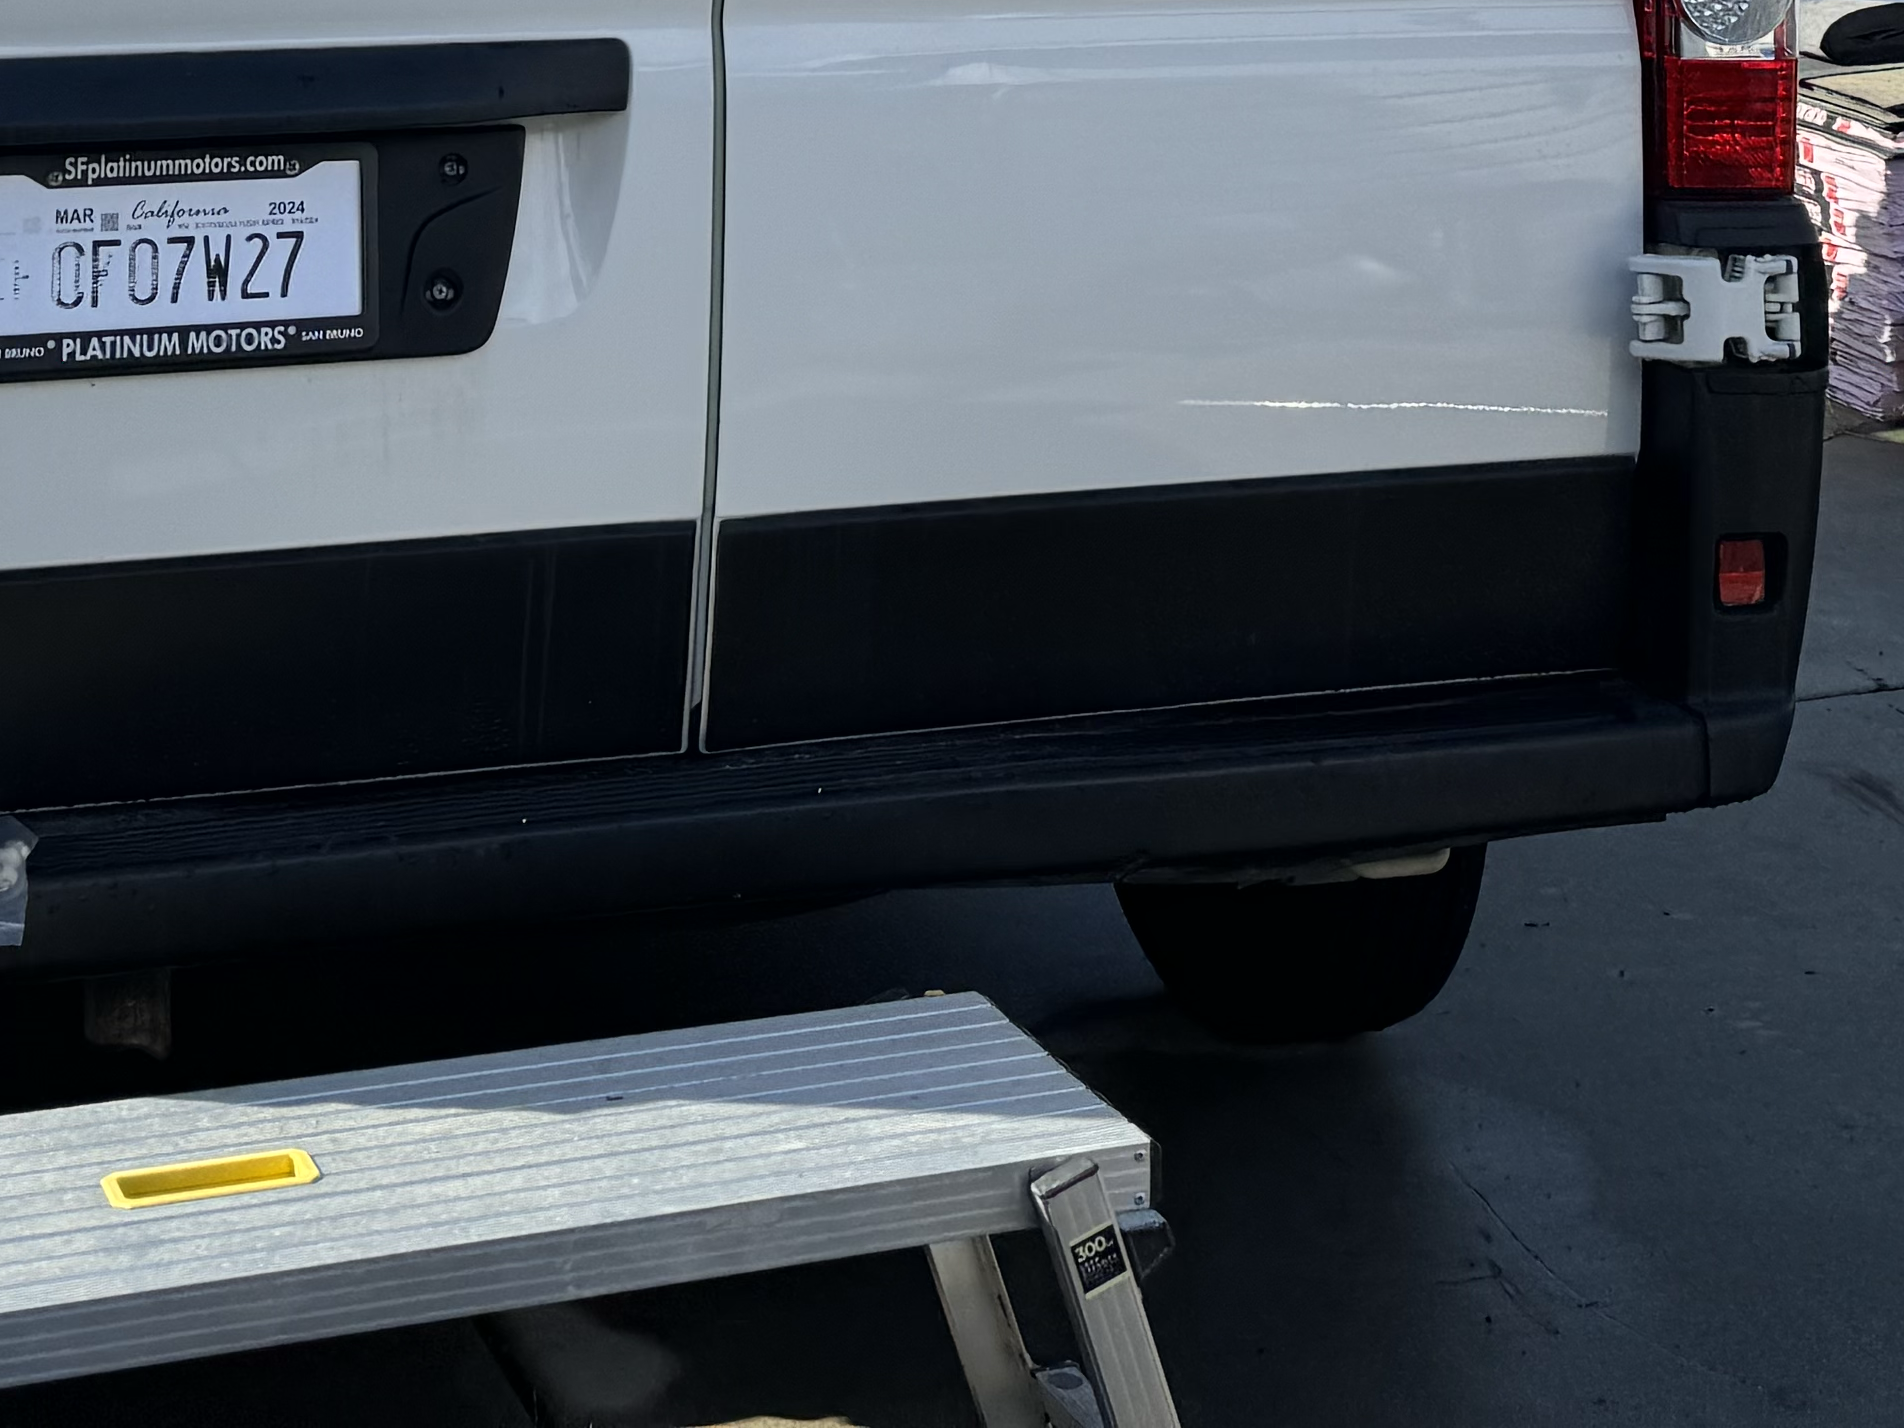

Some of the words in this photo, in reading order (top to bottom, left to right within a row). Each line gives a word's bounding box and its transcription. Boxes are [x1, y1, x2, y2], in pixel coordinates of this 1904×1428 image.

[64, 153, 285, 185] SFplatinummotors.com
[54, 207, 95, 225] MAR
[131, 200, 230, 229] California
[268, 201, 306, 216] 2024
[61, 331, 181, 362] PLATINUM
[187, 325, 287, 353] MOTORS
[301, 330, 325, 341] SAN
[1074, 1235, 1107, 1263] 300
